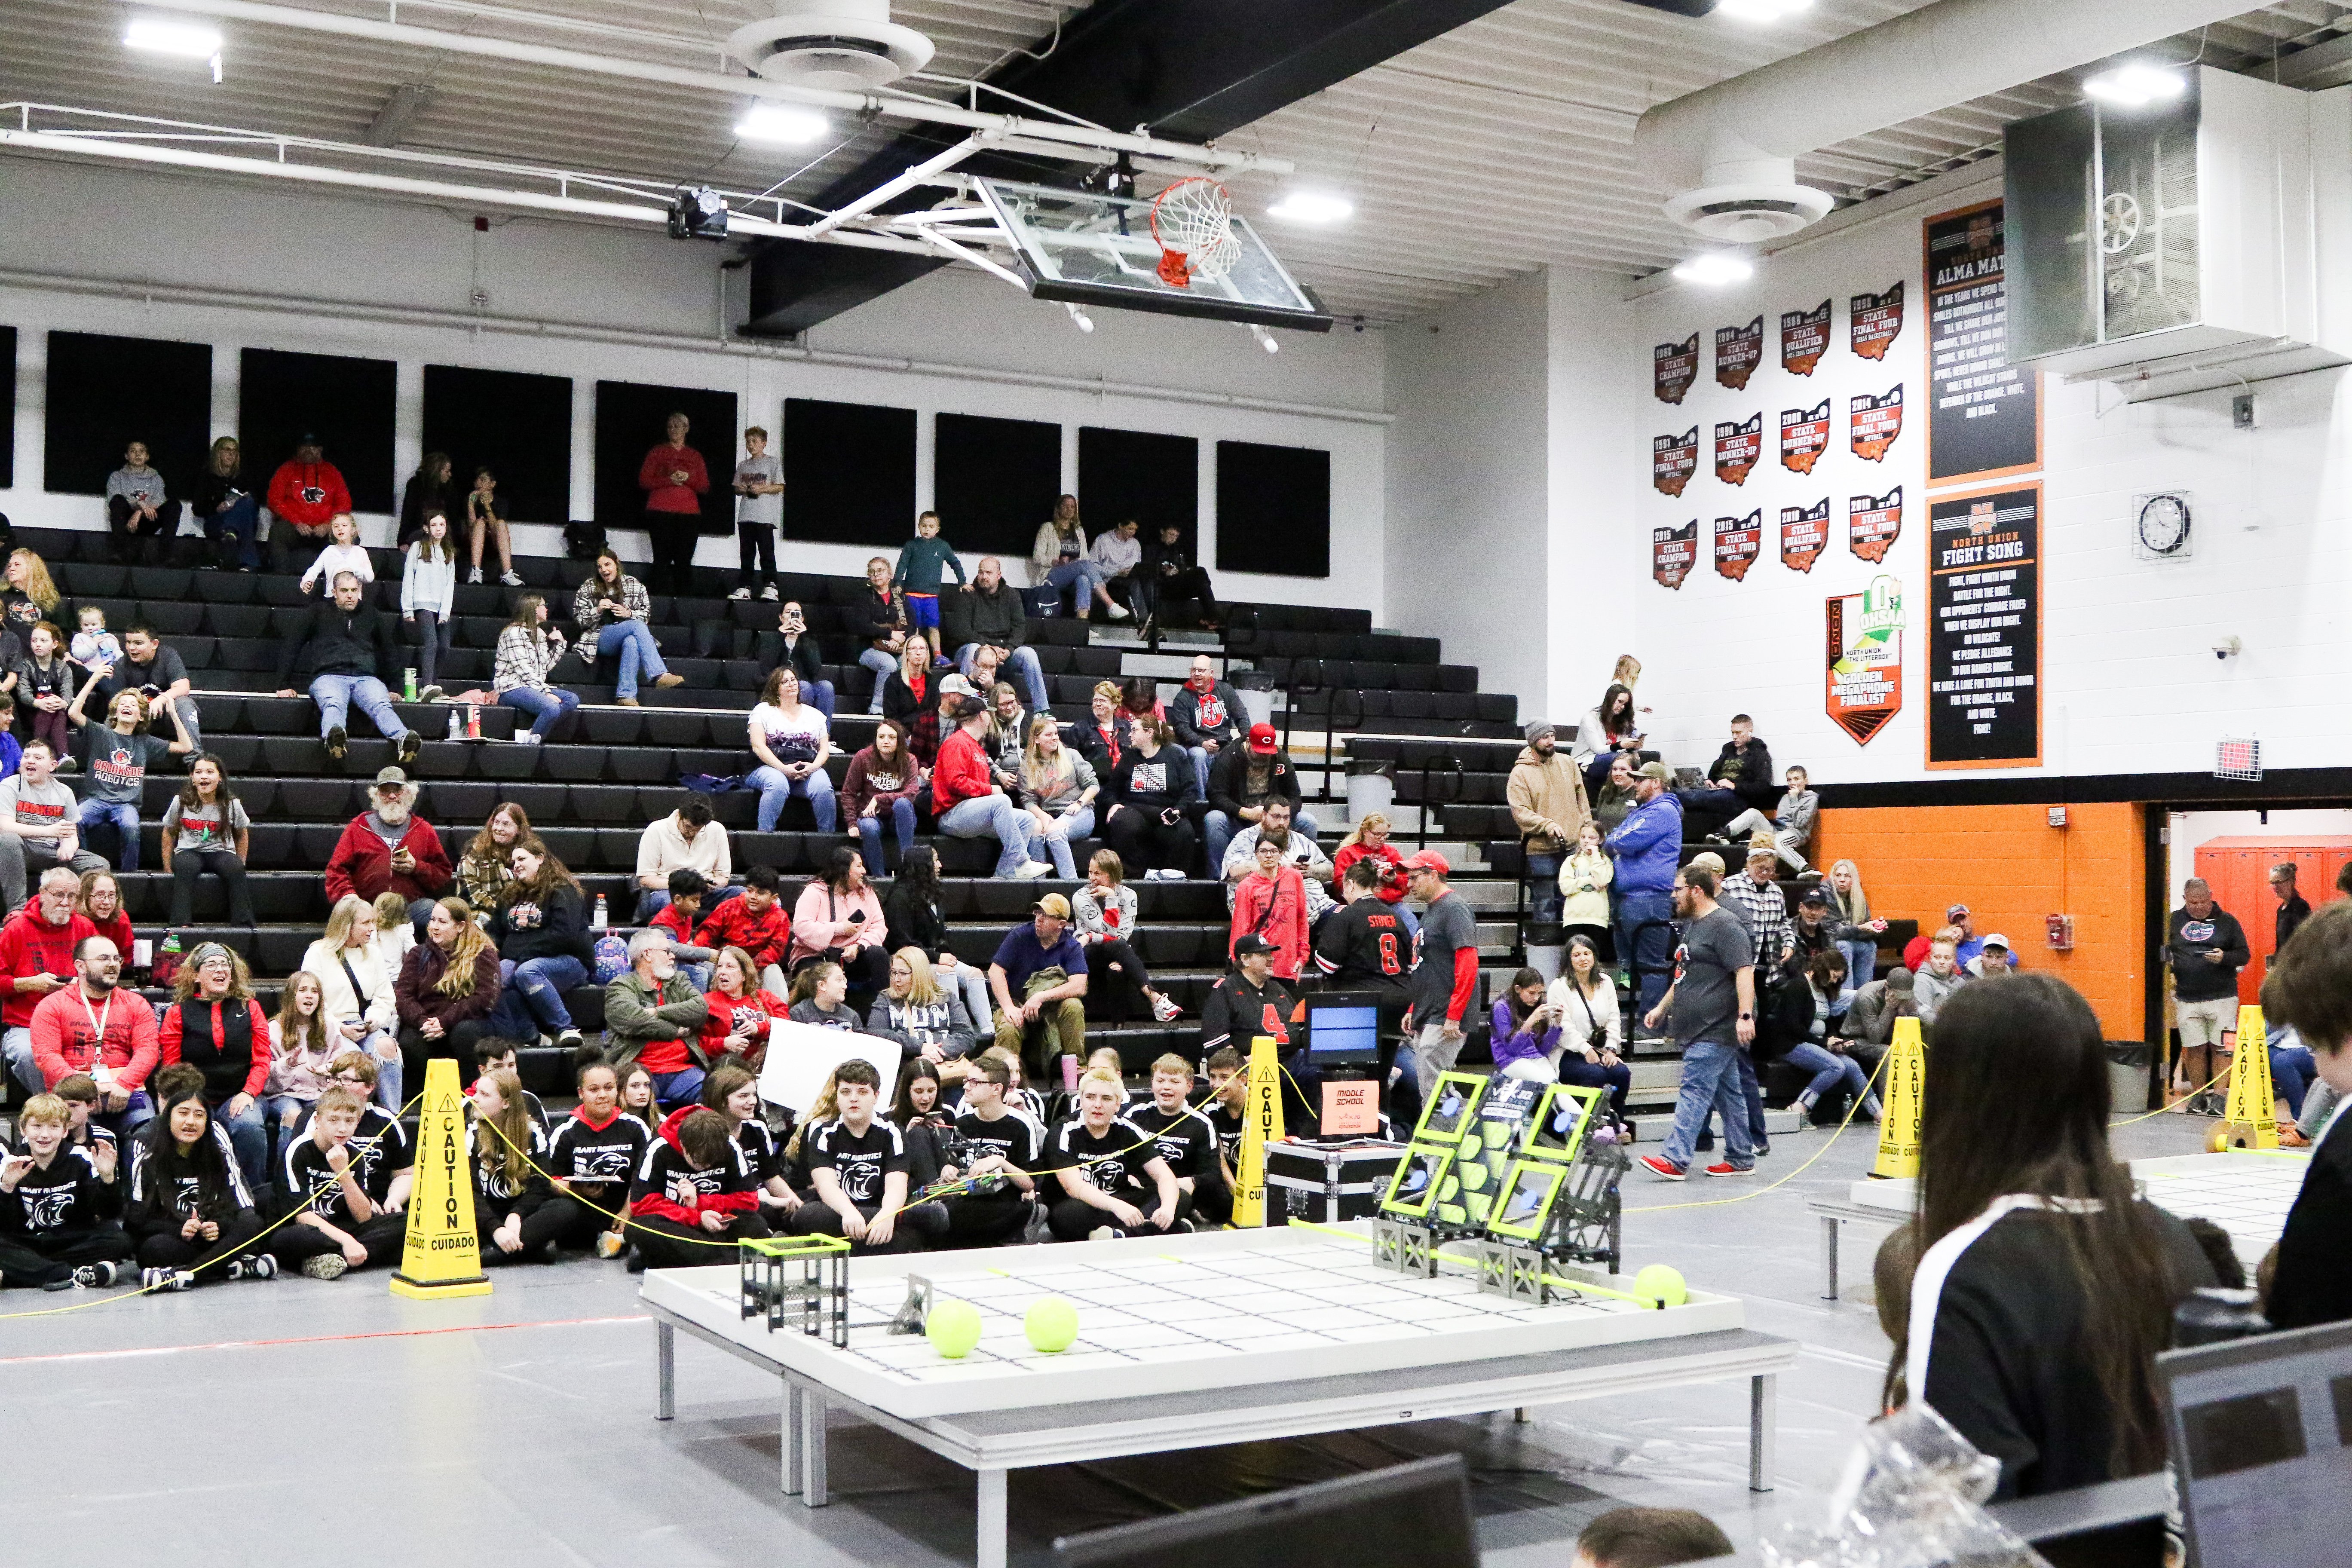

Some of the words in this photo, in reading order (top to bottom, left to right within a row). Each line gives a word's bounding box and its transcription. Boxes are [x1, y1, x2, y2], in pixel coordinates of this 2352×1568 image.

[1937, 262, 1975, 285] ALMA
[1977, 254, 2005, 276] MAT
[1944, 294, 1954, 305] THE
[1971, 288, 1980, 298] WE
[1863, 309, 1888, 322] STATE
[1853, 323, 1876, 335] FINAL
[1878, 317, 1898, 330] FOUR
[1793, 327, 1816, 340] STATE
[1868, 330, 1893, 340] BASKETBALL
[1727, 342, 1749, 354] STATE
[1786, 335, 1822, 352] QUALIFIER
[1664, 358, 1685, 369] STATE
[1718, 349, 1758, 366] RUNNER-UP
[1660, 366, 1690, 380] CHAMPION
[1963, 377, 1973, 390] THE
[1973, 373, 1996, 387] WILDCAT
[1997, 369, 2018, 383] STANDS
[1939, 394, 1965, 409] DEFENDER
[1965, 392, 1973, 404] OF
[1973, 390, 1984, 402] THE
[1862, 410, 1888, 423] STATE
[1966, 407, 1978, 419] AND
[1792, 424, 1816, 437] STATE
[1853, 424, 1876, 437] FINAL
[1878, 419, 1898, 432] FOUR
[1726, 437, 1749, 450] STATE
[1783, 432, 1825, 449] RUNNER-UP
[1864, 432, 1884, 442] SOFTBALL
[1664, 450, 1685, 461] STATE
[1717, 445, 1757, 461] RUNNER-UP
[1793, 446, 1812, 455] SOFTBALL
[1655, 462, 1675, 472] FINAL
[1677, 458, 1694, 469] FOUR
[1861, 511, 1887, 524] STATE
[1716, 520, 1733, 532] 2015
[1791, 523, 1815, 536] STATE
[1851, 524, 1875, 536] FINAL
[1877, 521, 1897, 533] FOUR
[1654, 530, 1671, 542] 2015
[1725, 533, 1748, 544] STATE
[1785, 532, 1822, 548] QUALIFIER
[1863, 534, 1883, 543] SOFTBALL
[1952, 536, 1984, 548] NORTH
[1988, 531, 2019, 544] UNION
[1663, 542, 1684, 554] STATE
[1716, 545, 1737, 555] FINAL
[1739, 542, 1757, 552] FOUR
[1942, 545, 1984, 566] FIGHT
[1987, 541, 2024, 560] SONG
[1658, 551, 1690, 564] CHAMPION
[1948, 575, 1965, 587] FIGHT,
[1966, 573, 1981, 585] FIGHT
[1981, 571, 2000, 584] NORTH
[2000, 569, 2017, 581] UNION
[1953, 589, 1972, 601] BATTLE
[1972, 588, 1983, 599] FOR
[1984, 587, 1994, 598] THE
[1994, 585, 2012, 597] RIGHT.
[1940, 606, 1951, 618] OUR
[1984, 600, 2009, 613] COURAGE
[2009, 599, 2026, 610] FADES
[1860, 609, 1905, 629] OHSAA
[1944, 620, 1960, 632] WHEN
[1960, 619, 1968, 630] WE
[1968, 617, 1991, 630] DISPLAY
[1991, 616, 2003, 628] OUR
[2003, 615, 2021, 626] MIGHT.
[1964, 634, 1972, 645] GO
[1972, 631, 2001, 645] WILDCATS!
[1952, 650, 1961, 661] WE
[1961, 648, 1981, 660] PLEDGE
[1981, 646, 2013, 659] ALLEGIANCE
[1952, 665, 1959, 676] TO
[1959, 664, 1971, 675] OUR
[1971, 662, 1992, 674] BANNER
[1843, 671, 1883, 684] GOLDEN
[1933, 681, 1942, 692] WE
[1941, 680, 1955, 691] HAVE
[1955, 680, 1960, 690] A
[1960, 679, 1974, 690] LOVE
[1974, 678, 1984, 689] FOR
[1985, 677, 2003, 688] TRUTH
[2003, 676, 2015, 687] AND
[2015, 674, 2034, 686] HONOR
[1831, 681, 1895, 696] MEGAPHONE
[1840, 692, 1886, 707] FINALIST
[1951, 695, 1961, 706] FOR
[1961, 694, 1972, 705] THE
[1972, 692, 1995, 704] ORANGE,
[1995, 692, 2015, 703] BLACK,
[1967, 709, 1978, 720] AND
[1973, 723, 1991, 734] FIGHT!
[93, 759, 144, 776] BROOKSIDE
[1275, 763, 1286, 775] B
[94, 770, 140, 786] ROBOTICS
[867, 773, 892, 784] NORTH
[873, 782, 892, 790] FACE
[1379, 933, 1401, 975] 8
[1262, 1003, 1289, 1044] 4
[2259, 1043, 2268, 1117] CAUTION
[1888, 1059, 1899, 1140] CAUTION
[597, 1144, 633, 1153] ROBOTICS
[982, 1138, 1012, 1147] ROBOTICS
[414, 1117, 429, 1228] CAUTION
[444, 1117, 457, 1229] CAUTION
[689, 1167, 726, 1180] ROBOTICS
[43, 1180, 77, 1194] ROBOTICS
[406, 1235, 425, 1250] CUIDADO
[431, 1236, 475, 1251] CUIDADO
